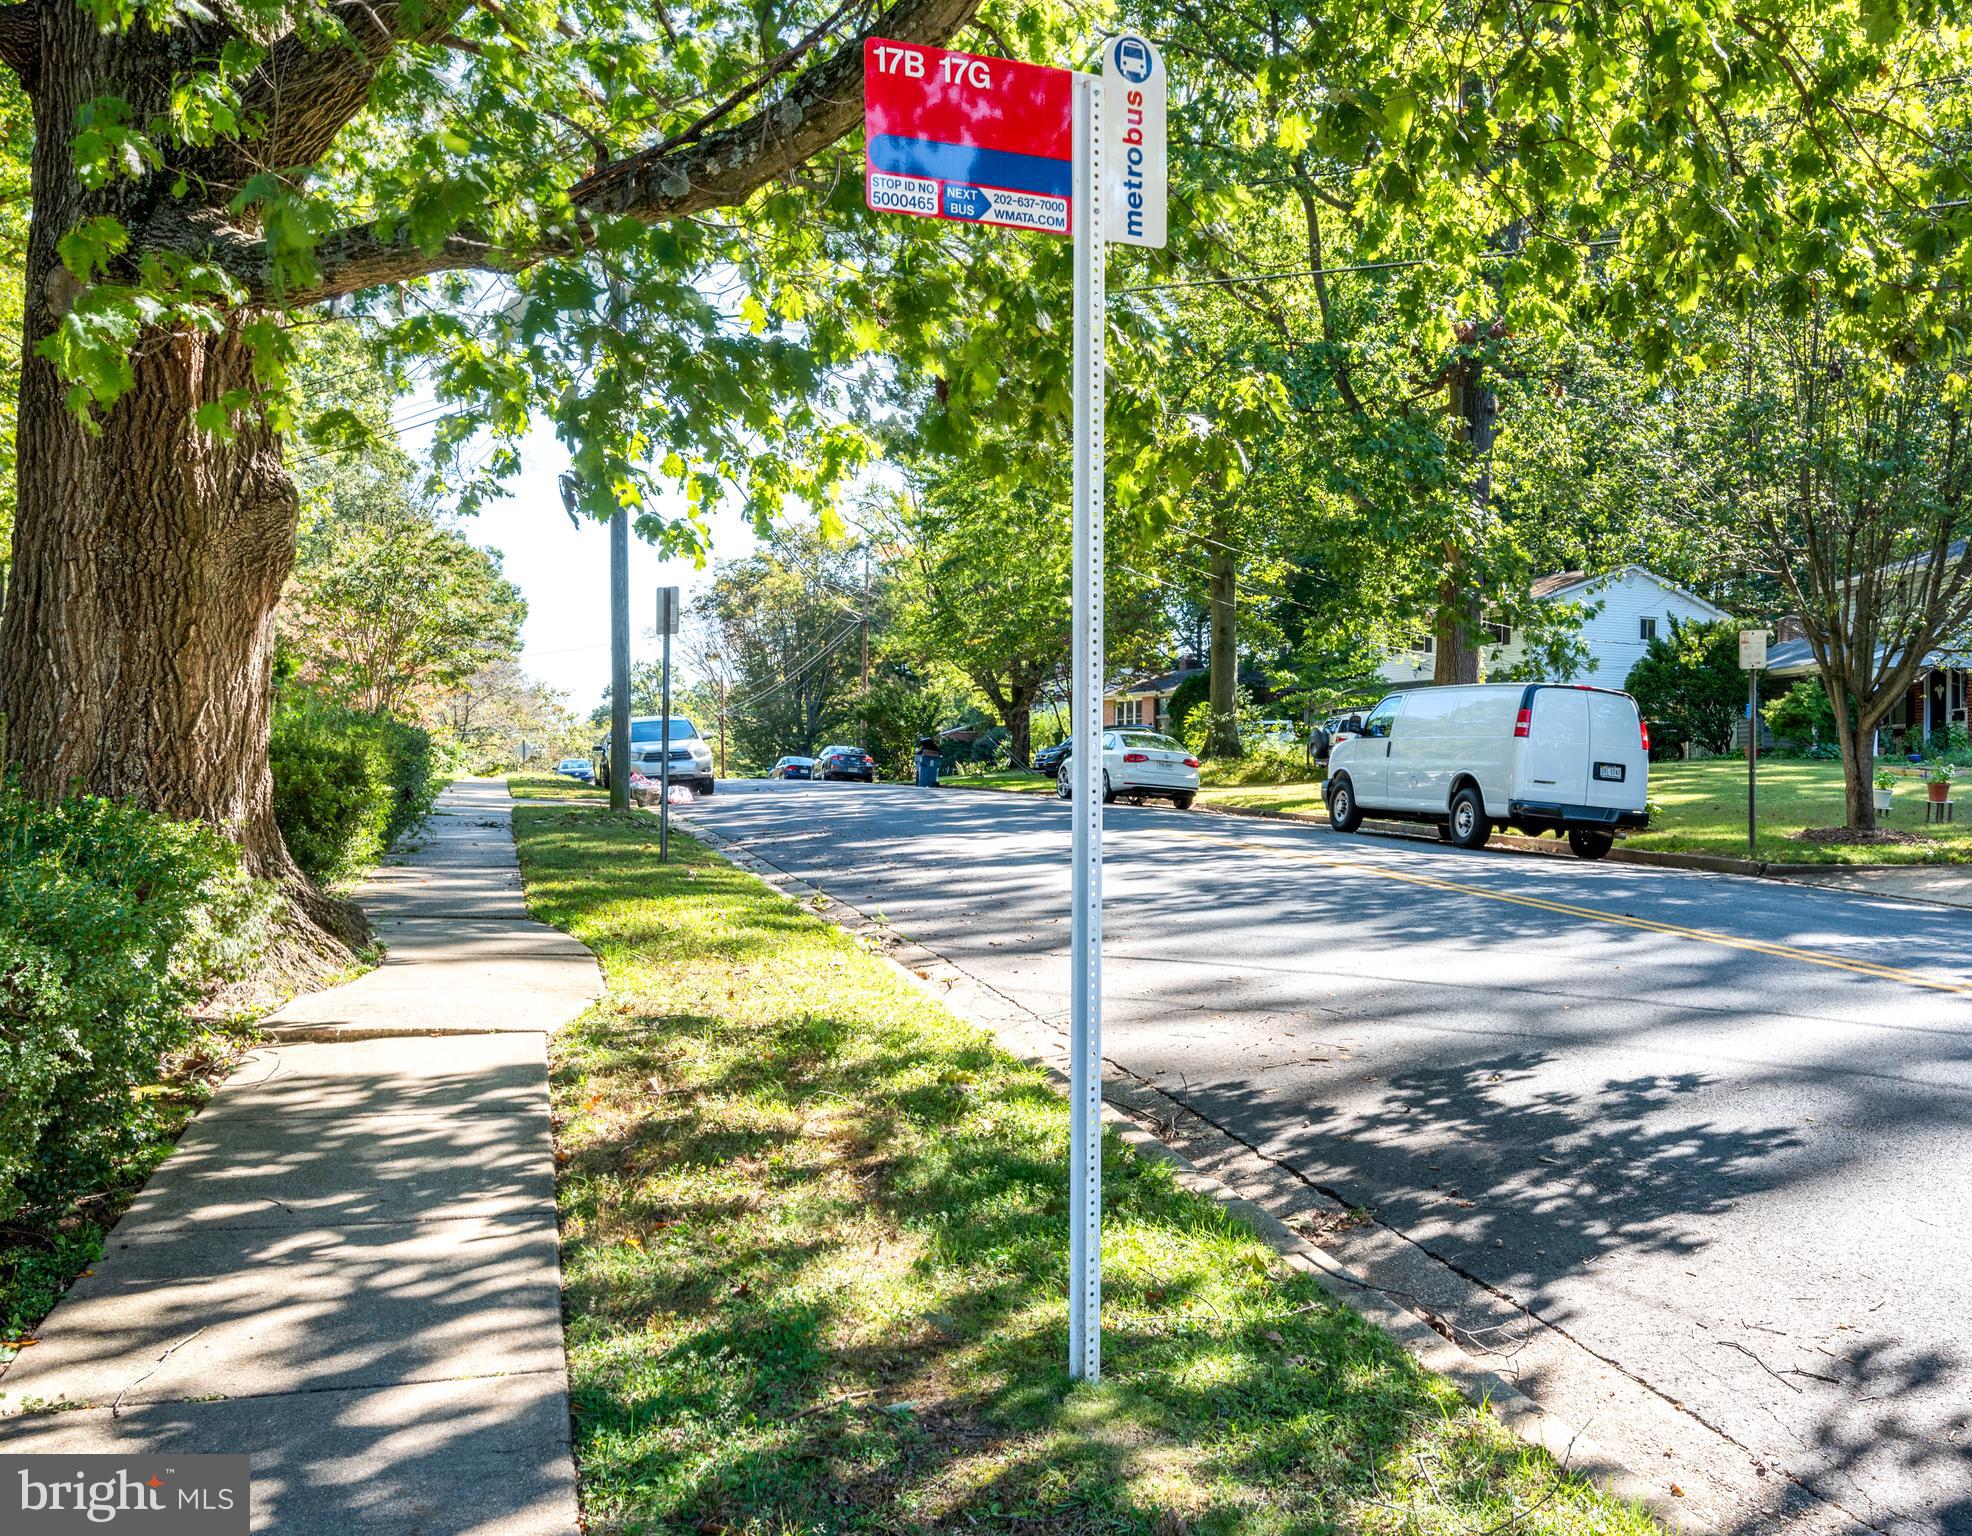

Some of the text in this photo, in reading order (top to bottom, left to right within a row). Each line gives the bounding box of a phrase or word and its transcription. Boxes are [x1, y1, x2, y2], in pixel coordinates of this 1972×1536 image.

[873, 46, 991, 90] 17B 17G
[1122, 90, 1143, 237] metrobus
[872, 176, 937, 195] STOP ID NO.
[947, 187, 978, 201] NEXT
[873, 191, 935, 211] 5000465
[950, 203, 975, 216] BUS
[993, 193, 1065, 213] 202-637-7000
[994, 208, 1065, 227] WMATA.COM
